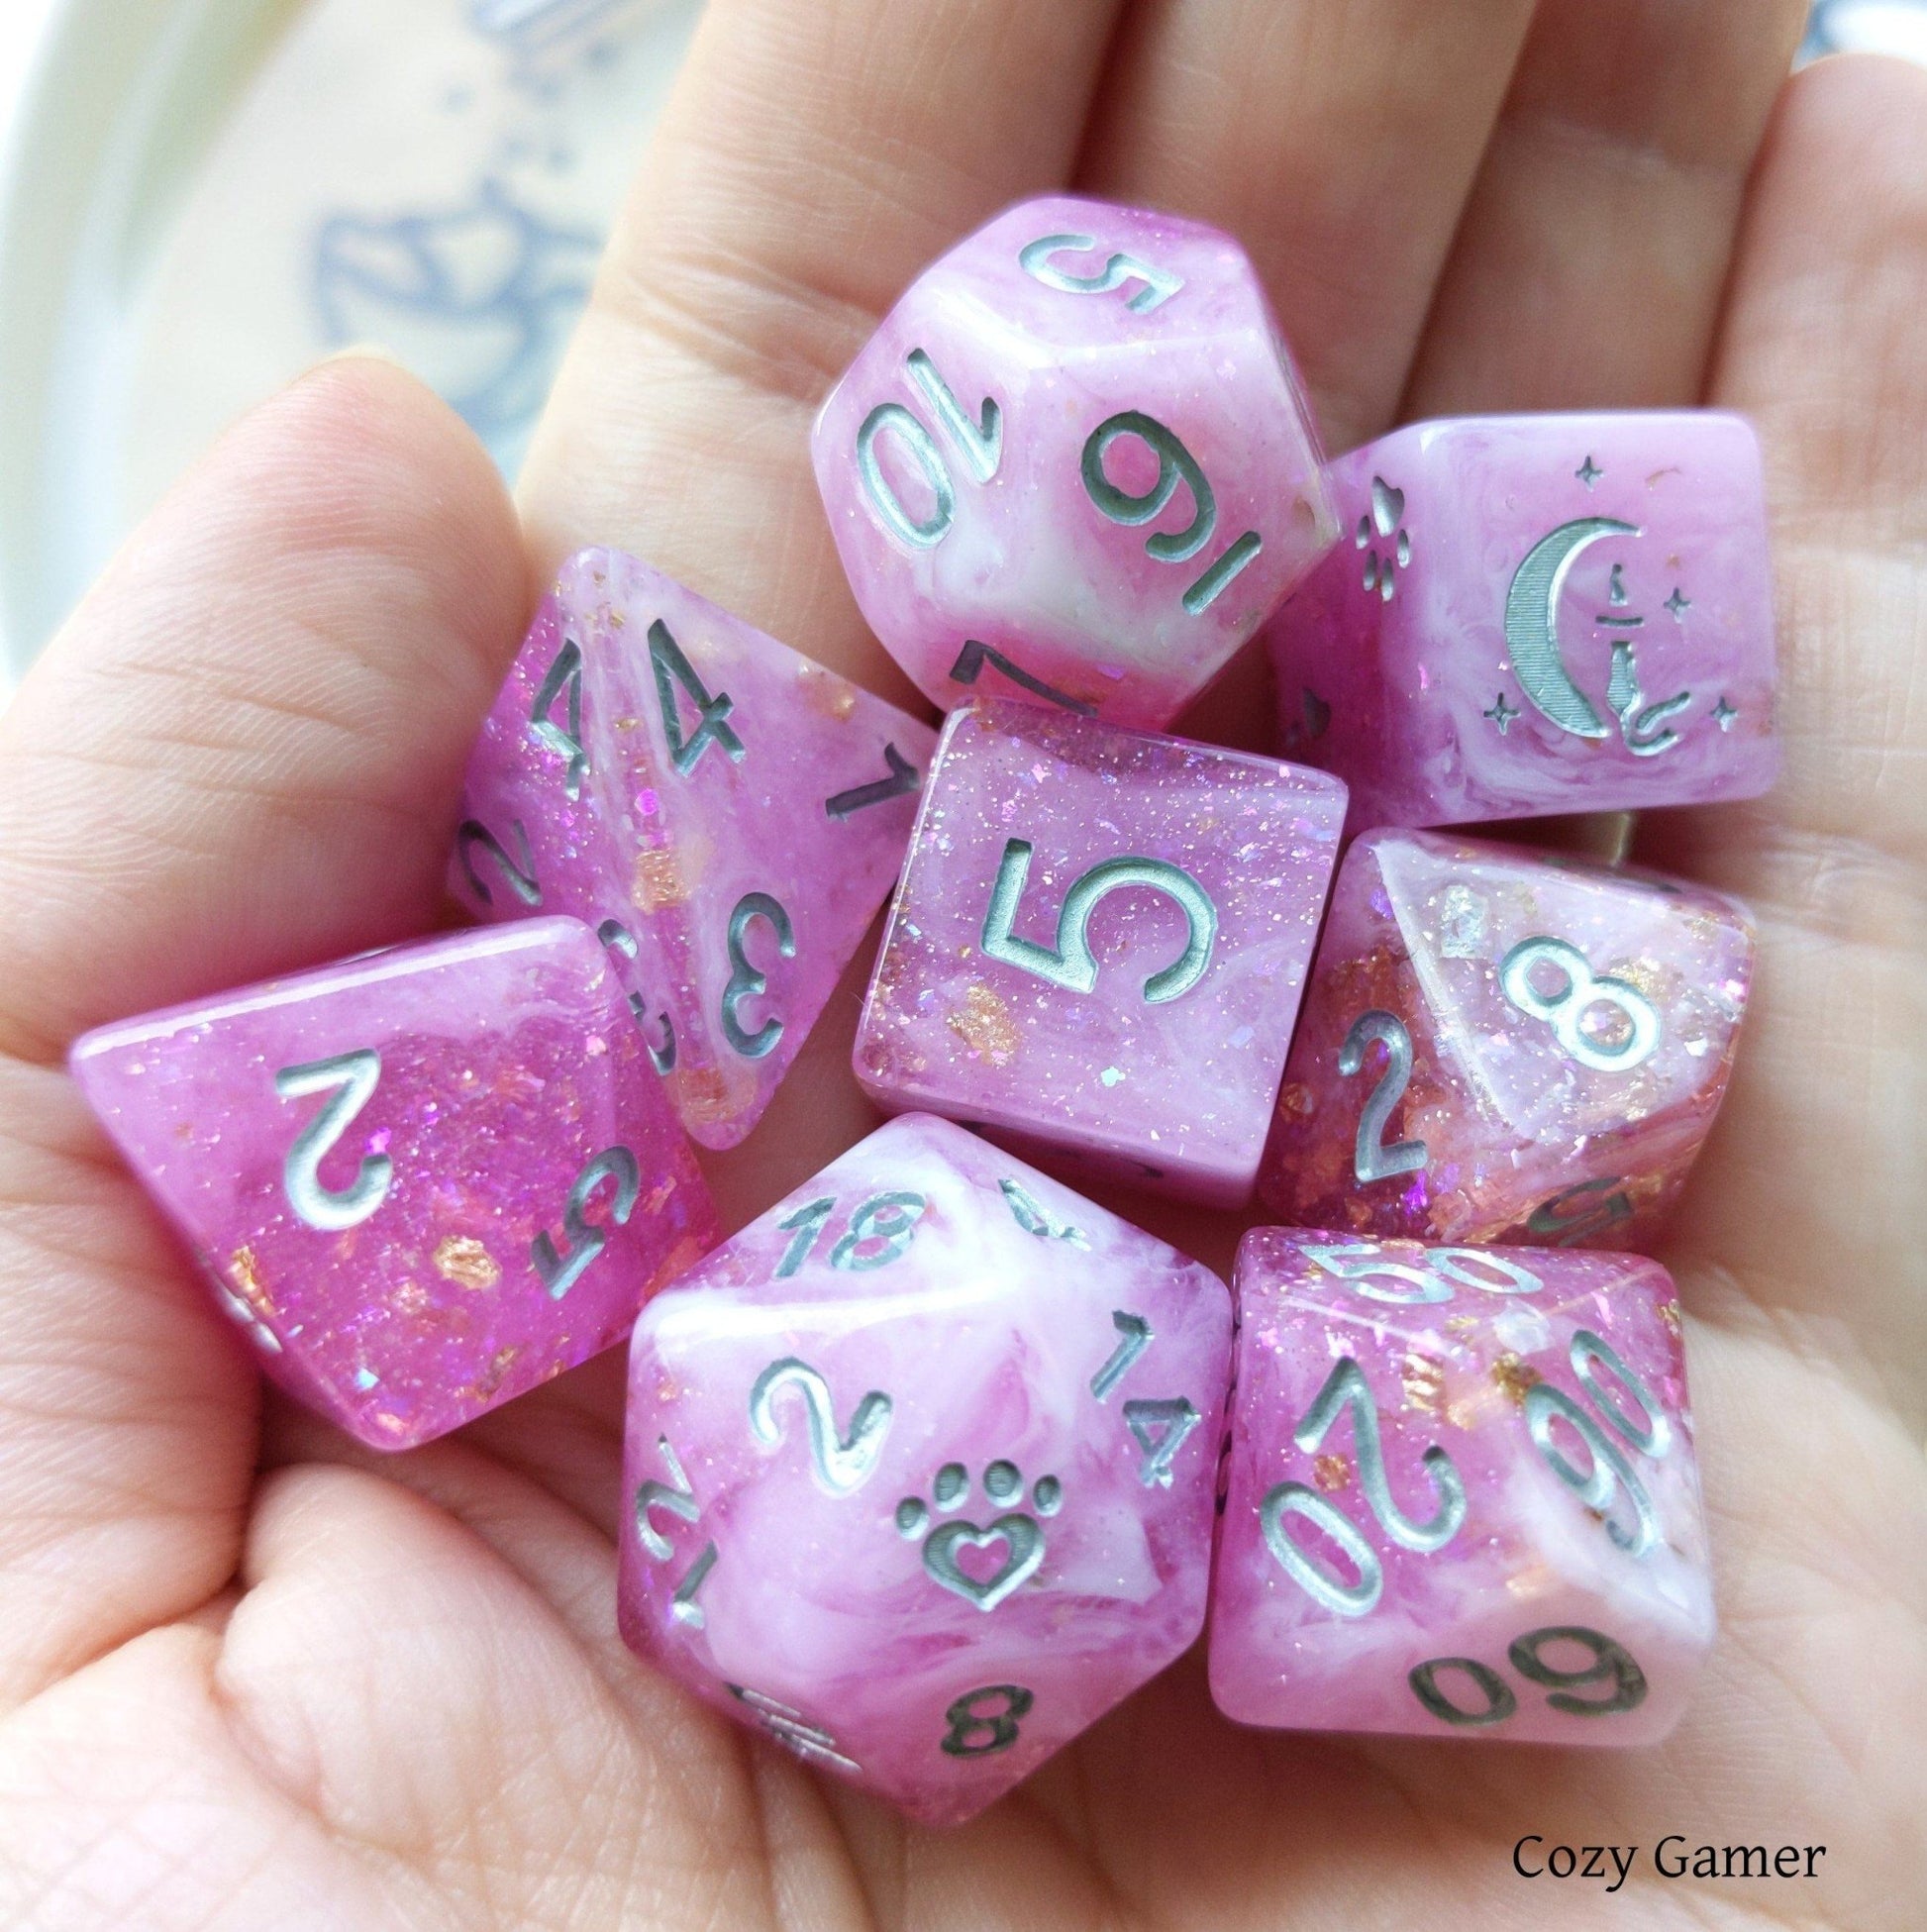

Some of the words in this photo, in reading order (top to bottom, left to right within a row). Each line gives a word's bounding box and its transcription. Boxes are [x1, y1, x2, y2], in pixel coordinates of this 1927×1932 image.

[1020, 235, 1184, 314] 5
[856, 348, 1003, 551] 10
[1081, 409, 1217, 563] 9
[531, 639, 591, 801] 4
[648, 618, 746, 776] 4
[825, 742, 921, 821] 1
[458, 819, 543, 906] 2
[981, 837, 1218, 1005] 5
[721, 891, 796, 1059] 3
[1499, 936, 1662, 1071] 8
[275, 1048, 393, 1231] 2
[1338, 1009, 1428, 1182] 2
[532, 1146, 641, 1300] 5
[774, 1191, 926, 1278] 18
[1297, 1243, 1545, 1305] 50
[750, 1357, 892, 1499] 2
[1090, 1309, 1202, 1488] 14
[1525, 1329, 1673, 1559] 90
[1260, 1356, 1469, 1618] 20
[940, 1684, 1035, 1759] 8
